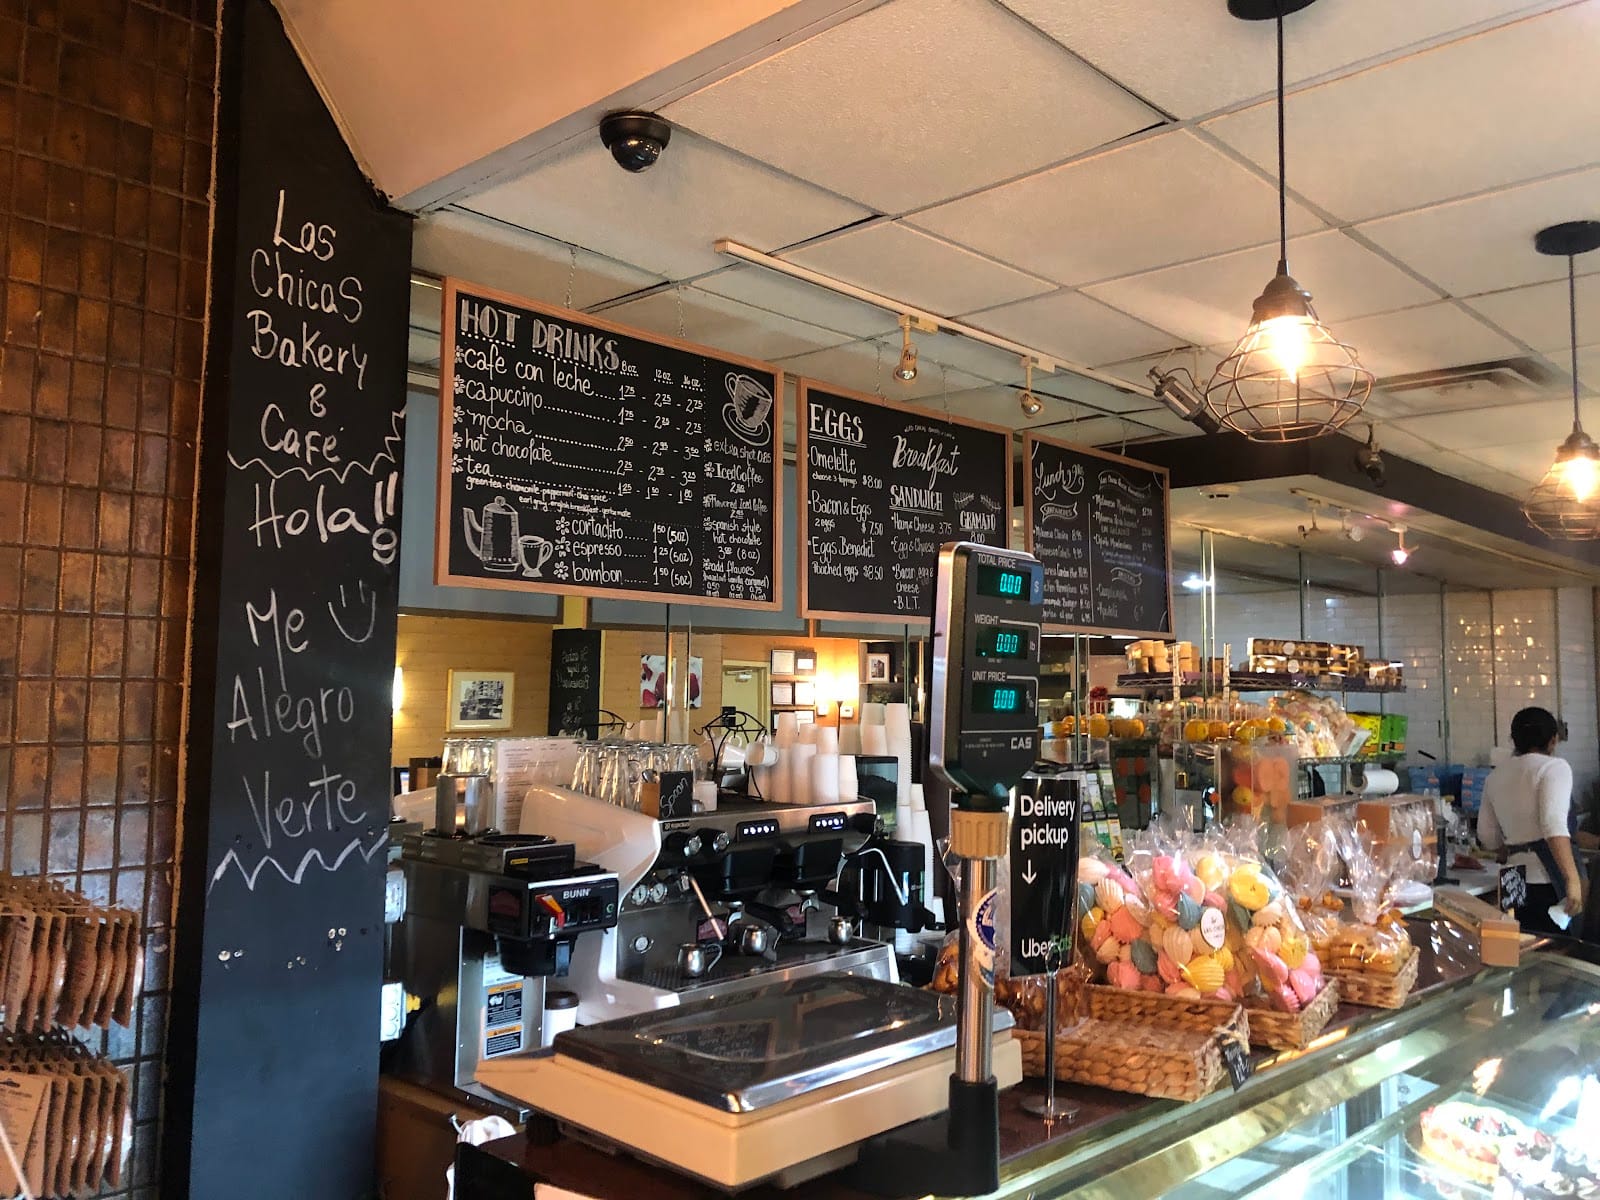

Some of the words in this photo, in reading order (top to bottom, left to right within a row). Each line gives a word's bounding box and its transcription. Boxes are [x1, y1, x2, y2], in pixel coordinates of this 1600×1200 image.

[251, 248, 363, 323] Chicas
[247, 309, 367, 390] Bakery
[461, 299, 520, 343] HOT
[532, 318, 620, 371] DRINKS
[464, 343, 508, 381] cafe
[515, 361, 544, 383] con
[553, 360, 595, 397] leche
[466, 380, 543, 416] capuccino
[467, 409, 533, 438] mocha
[809, 402, 864, 443] EGGS
[465, 427, 488, 454] hot
[491, 434, 553, 468] chocolate
[810, 445, 857, 475] Omelette
[464, 456, 494, 479] tea
[812, 490, 842, 515] Bacon
[850, 497, 872, 523] Eggs
[890, 485, 944, 512] SANDWICH
[572, 516, 624, 543] cortadito
[573, 541, 623, 563] espresso
[812, 536, 838, 564] Eggs
[977, 553, 997, 567] TOTAL
[998, 557, 1017, 570] PRICE
[572, 561, 624, 585] bombon
[974, 613, 1000, 627] WEIGHT
[246, 589, 309, 691] Me
[972, 671, 987, 682] UNIT
[988, 672, 1007, 682] PRICE
[227, 667, 355, 758] Alegro
[1010, 737, 1033, 751] CAS
[243, 765, 367, 848] Verte
[1020, 794, 1076, 821] Delivery
[1020, 822, 1069, 851] pickup
[563, 888, 591, 900] BUNN
